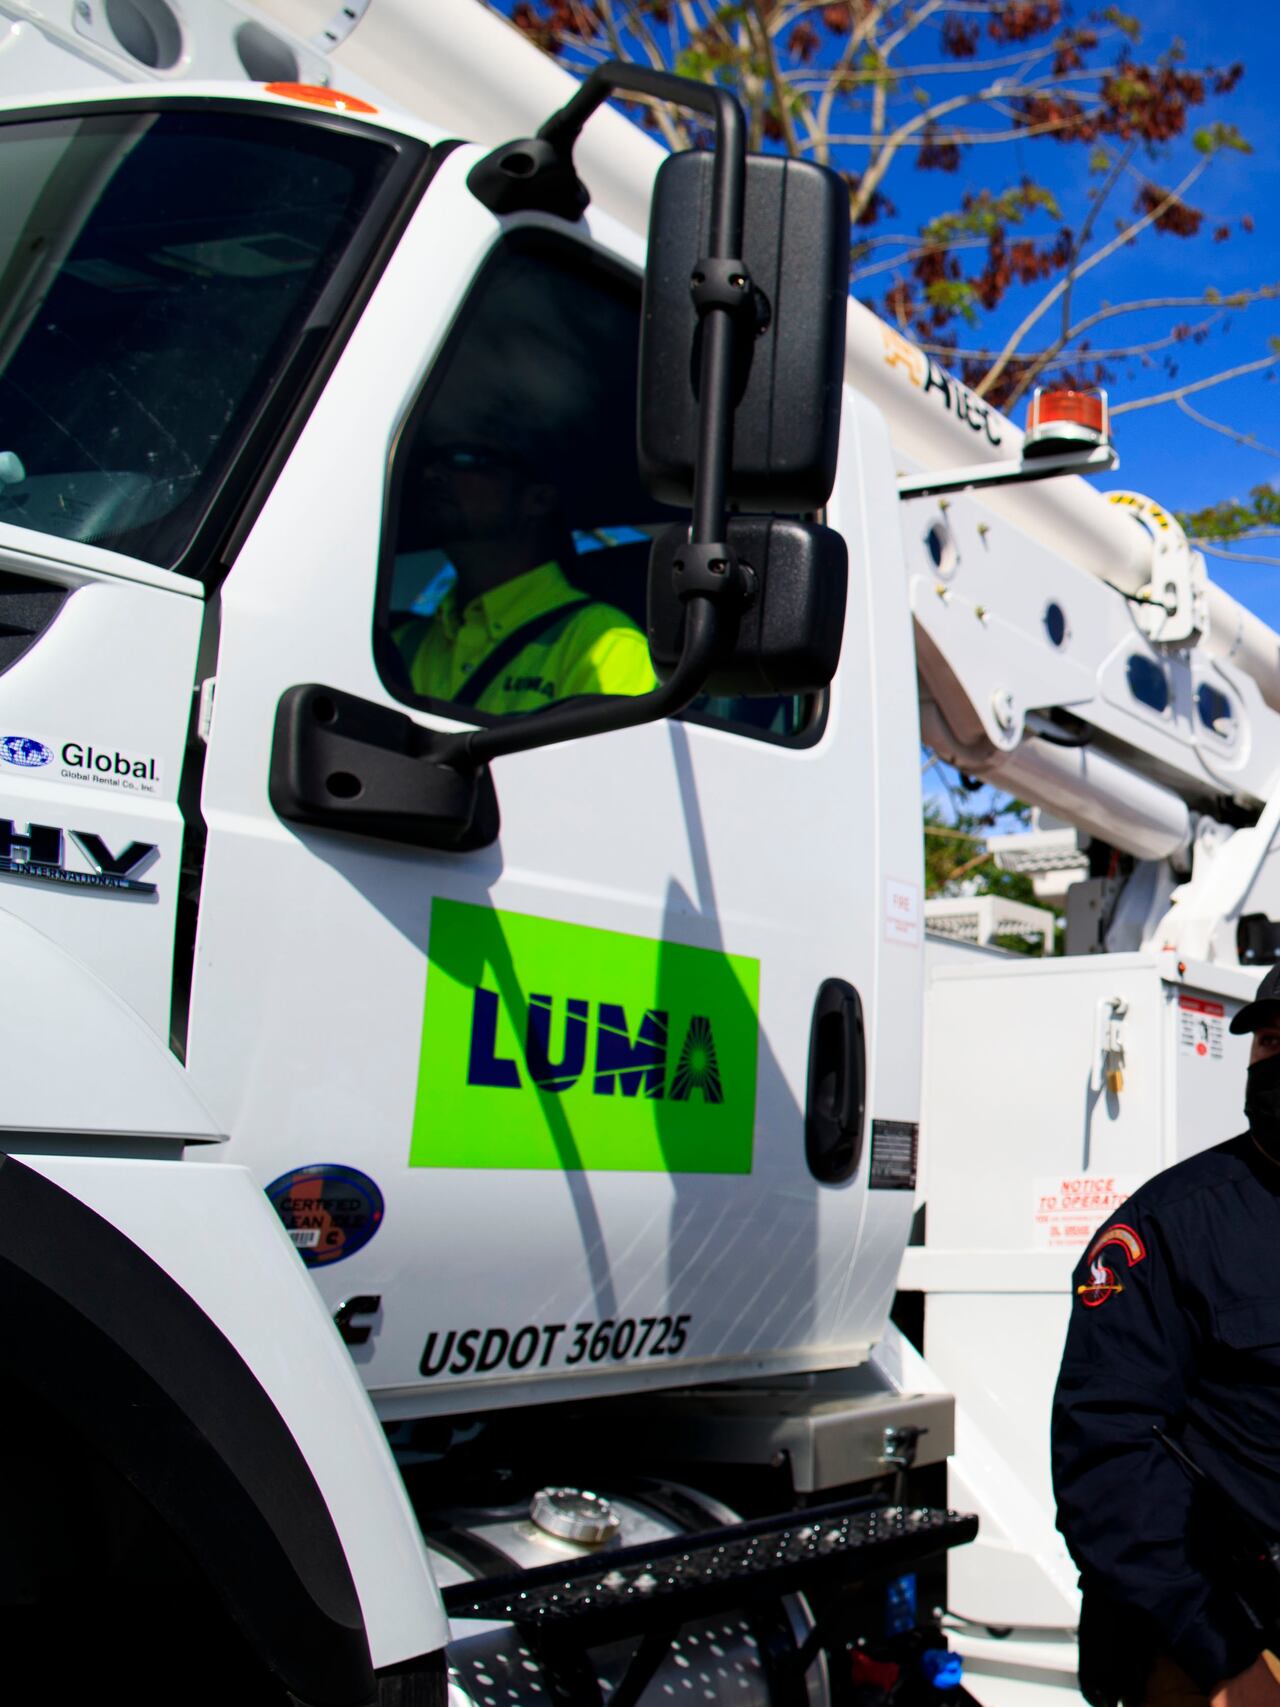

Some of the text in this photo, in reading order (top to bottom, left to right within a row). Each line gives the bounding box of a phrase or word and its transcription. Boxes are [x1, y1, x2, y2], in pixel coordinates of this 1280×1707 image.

[61, 742, 156, 781] Global
[61, 769, 90, 781] Global
[92, 775, 120, 786] Rental
[15, 864, 124, 888] INTERNATIONAL
[466, 984, 725, 1104] LUMA
[1062, 1178, 1114, 1193] NOTICE
[279, 1198, 362, 1212] CERTIFIED
[1040, 1196, 1057, 1209] TO
[418, 1315, 692, 1378] USDOT 360725
